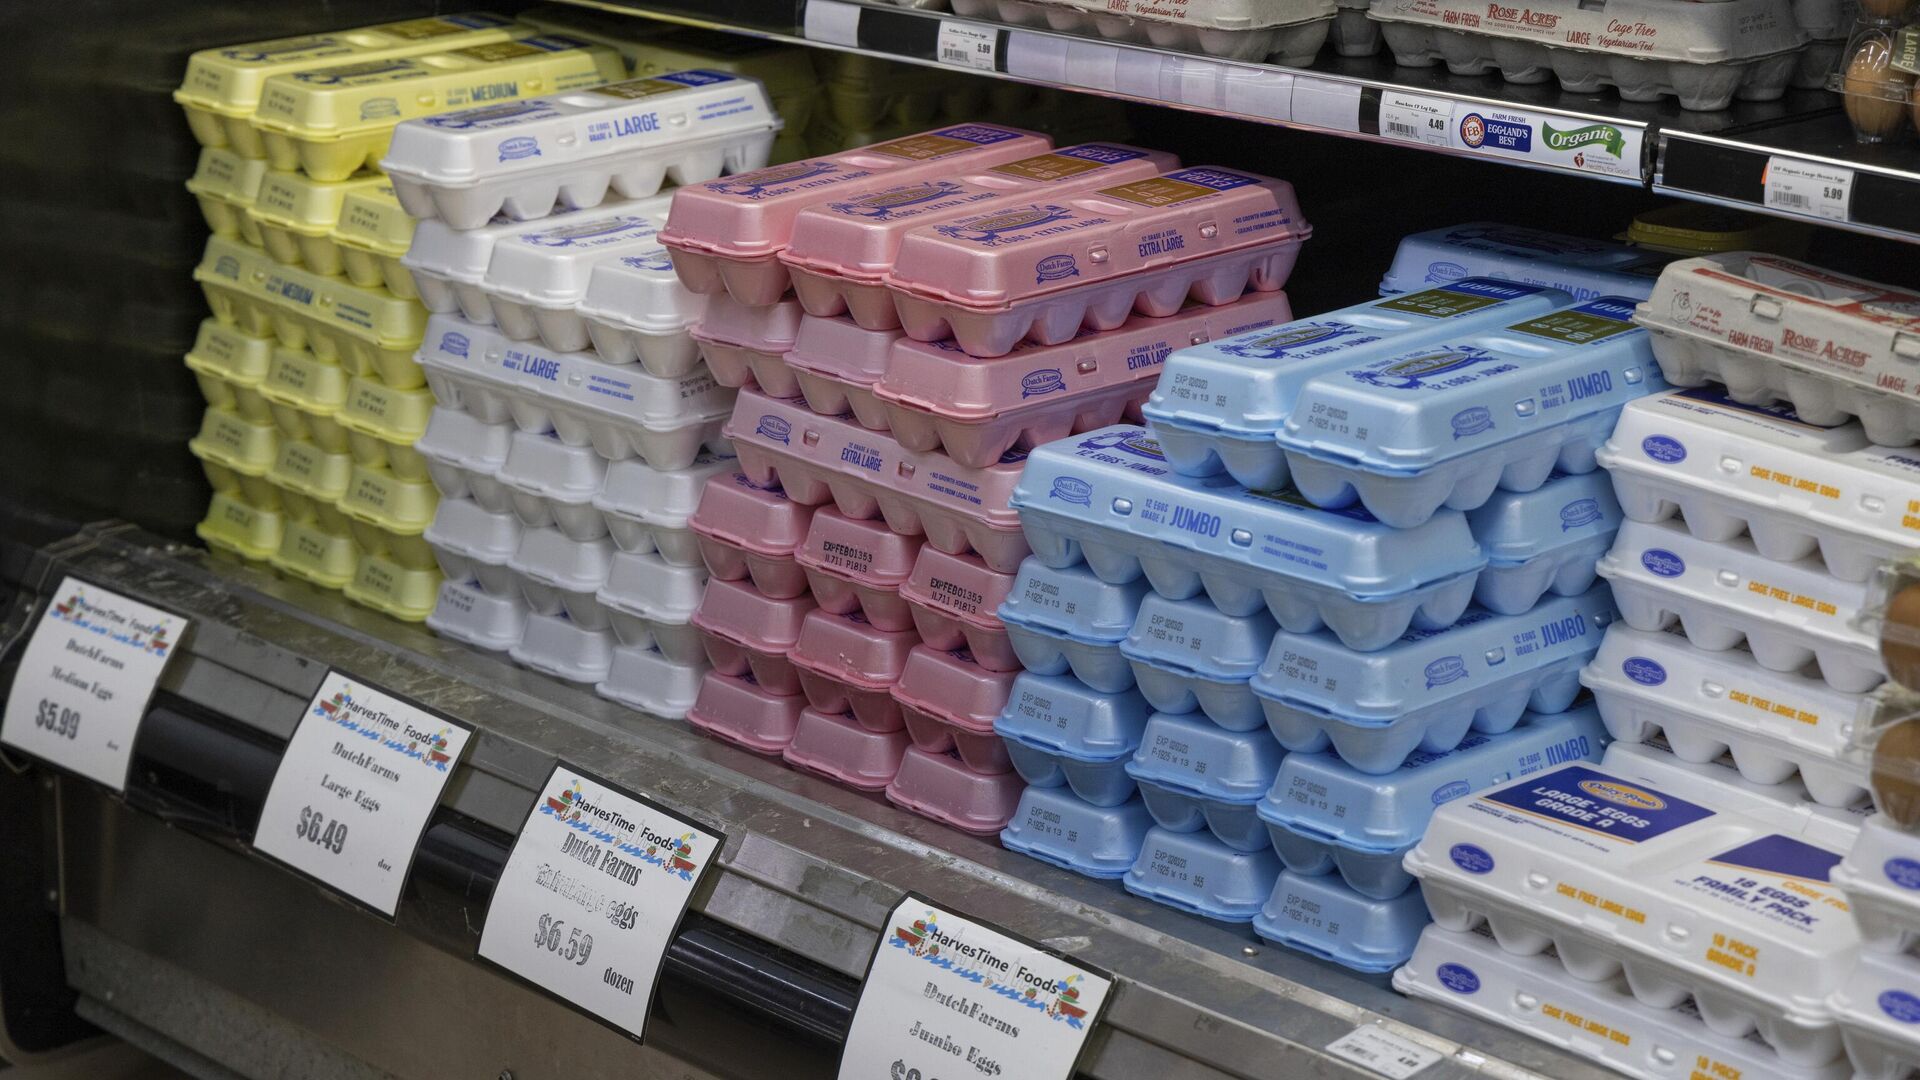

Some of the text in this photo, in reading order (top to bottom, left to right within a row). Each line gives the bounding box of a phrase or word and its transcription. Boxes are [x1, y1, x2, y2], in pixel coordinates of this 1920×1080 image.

[1107, 0, 1128, 12] LARGE
[1135, 3, 1186, 19] Vegetarian Fed
[1487, 3, 1558, 28] ROSE ACRES
[1443, 10, 1481, 28] FARM FRESH
[1607, 18, 1657, 38] Cage Free
[977, 43, 991, 55] 5.99
[1566, 30, 1590, 46] LARGE
[1597, 35, 1654, 52] Vegetarian Fed
[1900, 32, 1918, 67] LARGE
[470, 81, 518, 101] MEDIUM
[613, 112, 661, 138] LARGE
[1428, 118, 1444, 130] 4.49
[1491, 112, 1526, 124] FARM FRESH
[1466, 126, 1480, 136] EB
[1498, 135, 1516, 147] BEST
[1550, 126, 1615, 147] Organic
[800, 179, 833, 194] EXTRA
[1823, 186, 1843, 200] 5.99
[926, 200, 957, 214] EXTRA
[1035, 226, 1066, 240] EXTRA
[1068, 217, 1111, 233] LARGE
[1138, 235, 1185, 257] EXTRA LARGE
[1039, 260, 1073, 272] Dutch Farms
[1728, 329, 1774, 354] FARM FRESH
[1781, 328, 1820, 351] ROSE
[1820, 340, 1867, 368] ACRES
[523, 350, 560, 382] LARGE
[1024, 374, 1059, 387] Dutch Farms
[1427, 364, 1520, 391] 12 EGGS JUMBO
[1566, 370, 1613, 402] JUMBO
[1876, 371, 1907, 394] LARGE
[1539, 384, 1563, 396] 12 EGGS
[840, 447, 883, 472] EXTRA LARGE
[1076, 450, 1168, 477] 12 EGGS JUMBO
[1056, 479, 1090, 494] Dutch Farms
[1751, 465, 1841, 499] CAGE FREE LARGE EGGS
[1145, 498, 1168, 513] 12 EGGS
[1141, 510, 1165, 525] GRADE A
[1169, 505, 1221, 538] JUMBO
[845, 559, 867, 574] P1813
[1029, 578, 1041, 590] EXP
[953, 597, 977, 615] P1813
[1051, 600, 1060, 608] 13
[1151, 614, 1164, 625] EXP
[1175, 635, 1185, 645] 13
[1513, 630, 1536, 645] 12 EGGS
[1540, 614, 1587, 648] JUMBO
[65, 638, 125, 671] DutchFarms
[1534, 642, 1540, 652] A
[50, 666, 114, 702] Medium Eggs
[1750, 695, 1770, 711] FREE
[35, 697, 81, 741] $5.99
[344, 698, 433, 746] HarvesTime Foods
[331, 741, 401, 784] DutchFarms
[1518, 752, 1541, 767] 12 EGGS
[320, 773, 382, 813] Large Eggs
[1532, 786, 1595, 809] LARGE
[1598, 806, 1651, 829] EGGS
[1535, 798, 1616, 828] GRADE A
[296, 804, 349, 855] $6.49
[574, 796, 675, 852] HarvesTime Foods
[377, 858, 392, 873] doz
[560, 831, 643, 888] Dutch Farms
[1154, 849, 1168, 862] EXP
[1179, 872, 1187, 881] 13
[1692, 876, 1766, 904] FAMILY
[1764, 902, 1820, 925] PACK
[1733, 877, 1810, 908] 18 EGGS
[534, 912, 594, 967] $6.59
[1713, 933, 1760, 960] 18 PACK
[930, 927, 1060, 996] HarvesTime Foods
[1706, 948, 1756, 977] GRADE A
[603, 966, 634, 996] dozen
[923, 981, 1021, 1040] DutchFarms
[908, 1020, 963, 1057] Jumbo
[966, 1046, 1003, 1077] Eggs
